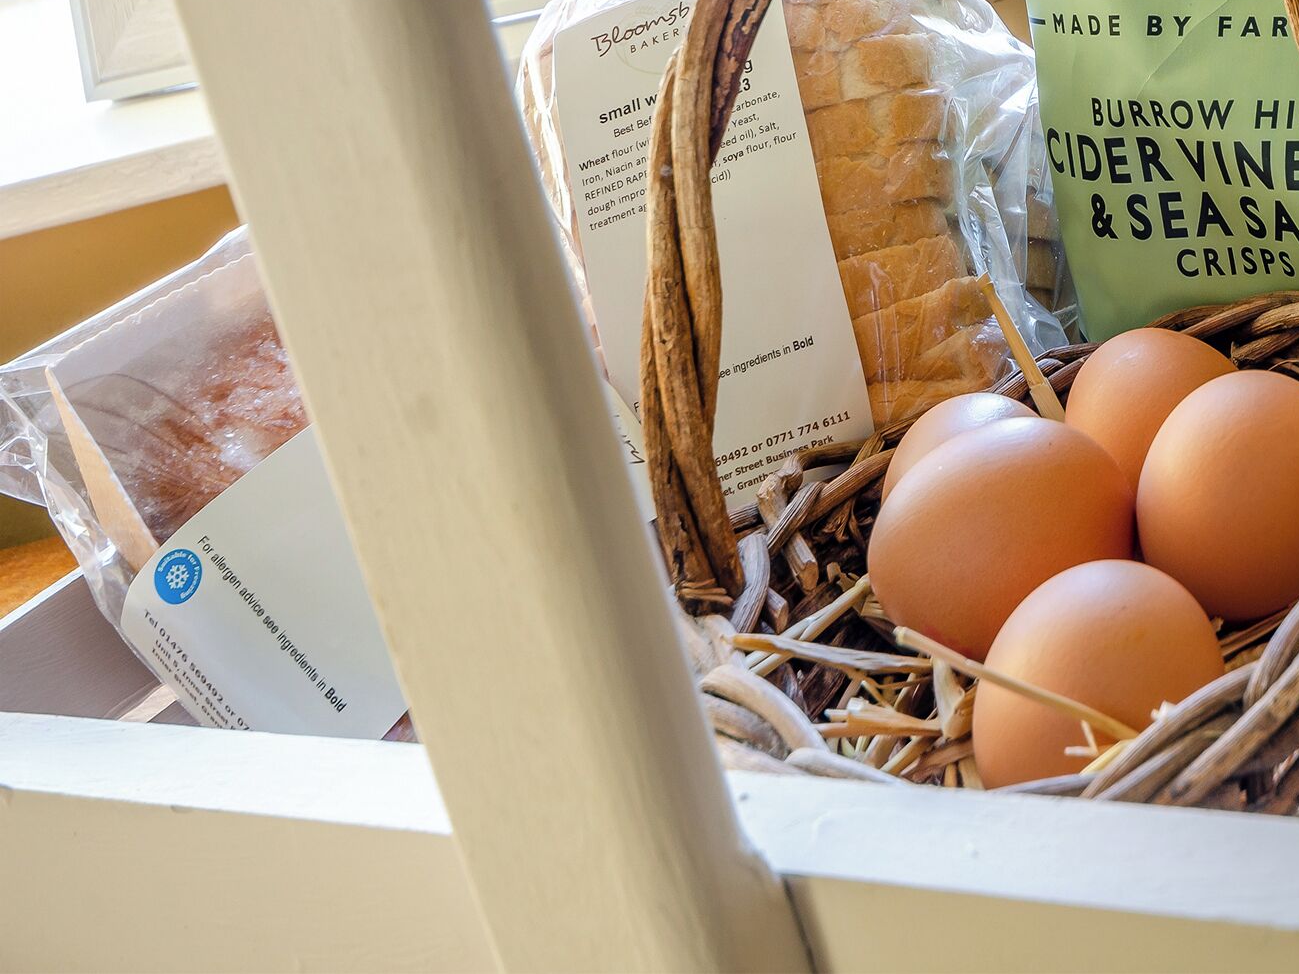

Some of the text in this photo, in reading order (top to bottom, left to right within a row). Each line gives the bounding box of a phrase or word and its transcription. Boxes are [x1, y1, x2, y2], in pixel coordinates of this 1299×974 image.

[1052, 13, 1121, 36] MADE
[1146, 15, 1192, 37] BY
[630, 27, 681, 54] BAKER
[599, 98, 641, 124] small
[732, 113, 760, 128] Yeast,
[1091, 97, 1235, 130] BURROW
[613, 123, 635, 138] Best
[759, 121, 780, 134] Salt,
[579, 153, 611, 171] Wheat
[611, 143, 634, 159] flour
[723, 150, 744, 164] soya
[746, 140, 772, 154] flour,
[773, 132, 797, 145] flour
[1047, 127, 1175, 183] CIDER
[581, 161, 634, 186] Iron, Niacin
[585, 179, 624, 201] REFINED
[587, 199, 616, 216] dough
[589, 207, 636, 231] treatment
[1177, 246, 1296, 278] CRISPS
[732, 336, 814, 373] ingredients in Bold
[751, 411, 850, 453] or 0771 774 6111
[735, 435, 834, 477] Street Park
[197, 535, 347, 713] For allergen advice ingredients in Bold
[144, 609, 158, 628] Tel
[159, 627, 188, 662] 01476
[189, 662, 224, 702] 569492
